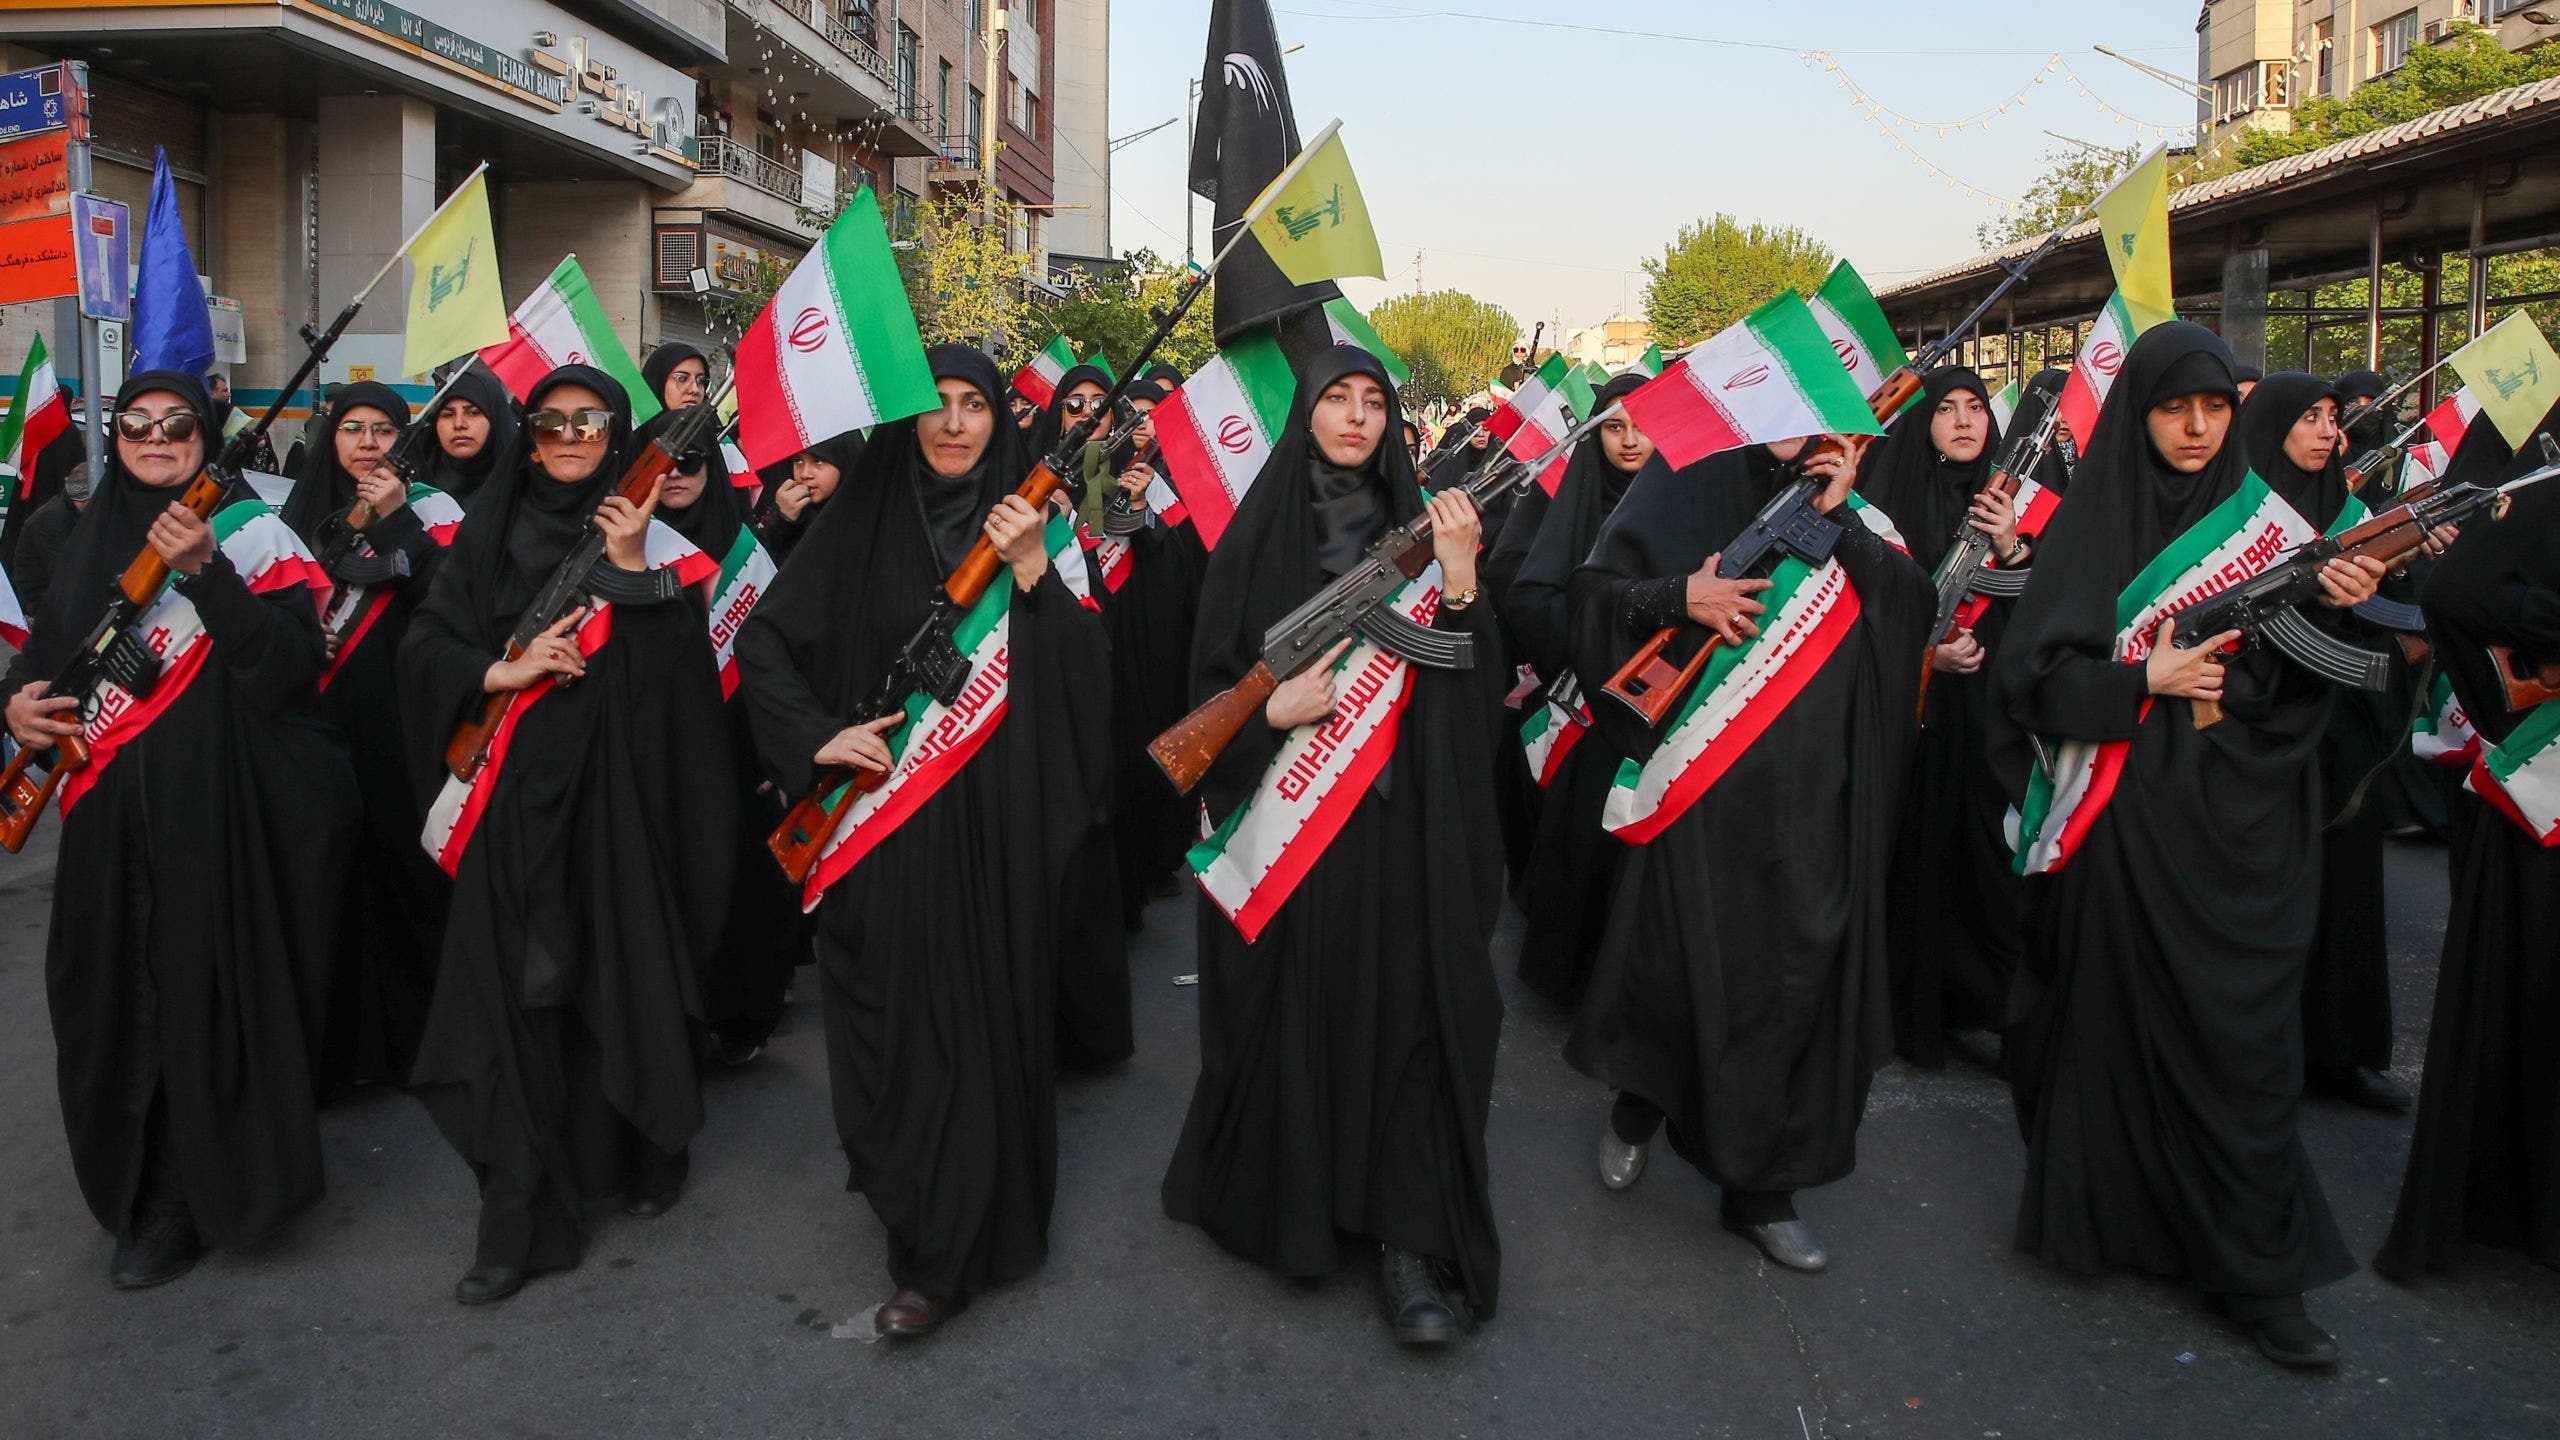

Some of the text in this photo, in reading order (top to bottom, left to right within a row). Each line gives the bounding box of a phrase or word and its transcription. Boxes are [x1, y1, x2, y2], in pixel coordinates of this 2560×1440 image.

[496, 55, 560, 102] TEJARAT BANK
[5, 158, 28, 176] شماره
[31, 151, 61, 171] ساختمان
[35, 181, 65, 200] دادگستری
[30, 248, 68, 263] دانشکده
